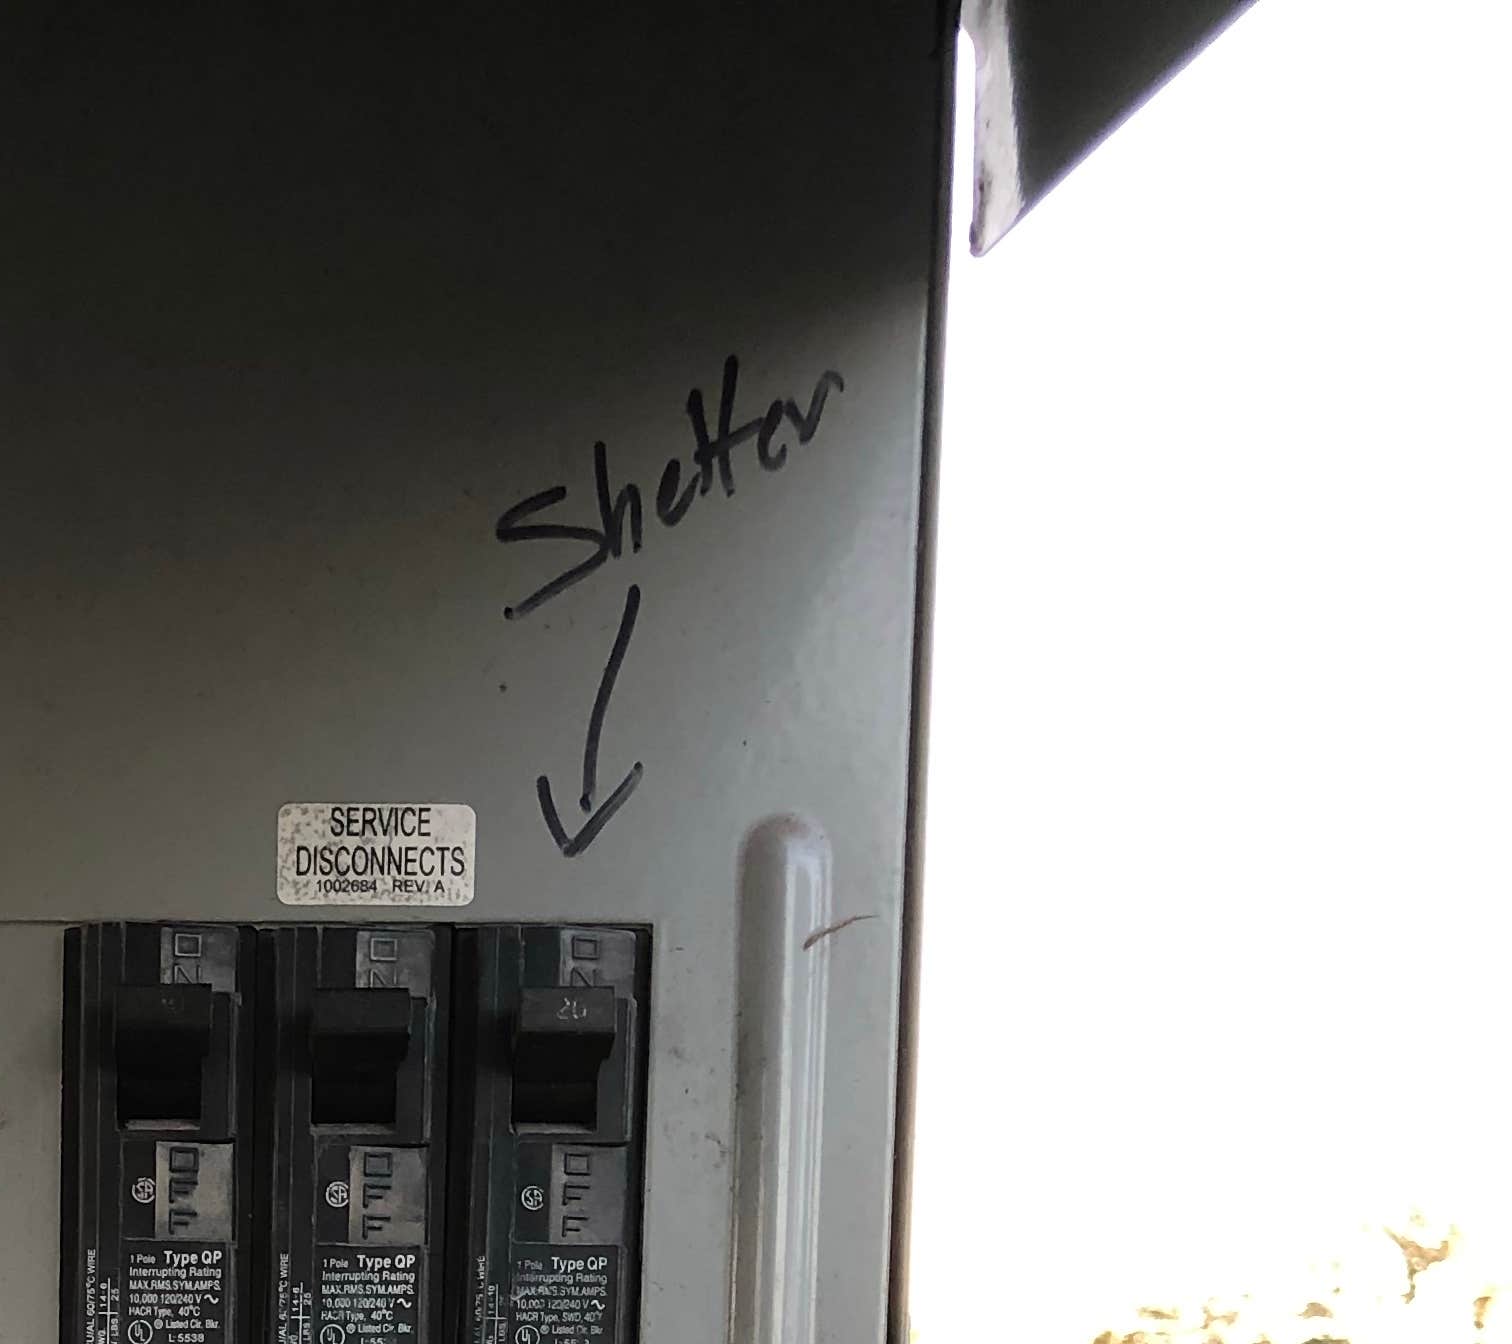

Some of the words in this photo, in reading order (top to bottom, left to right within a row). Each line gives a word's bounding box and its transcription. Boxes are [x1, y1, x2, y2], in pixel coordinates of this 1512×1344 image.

[495, 354, 844, 620] Shelter
[330, 807, 431, 836] SERVICE
[296, 846, 465, 876] DISCONNECTS
[317, 880, 377, 892] 1002684
[434, 880, 445, 892] A
[168, 1148, 199, 1235] OFF
[362, 1152, 393, 1239] OFF
[561, 1152, 590, 1238] OFF
[87, 1248, 96, 1273] WIRE
[163, 1251, 198, 1267] Type
[201, 1251, 222, 1264] QP
[280, 1253, 289, 1278] WIRE
[357, 1254, 391, 1271] Type
[395, 1255, 416, 1268] QP
[551, 1257, 584, 1272] Type
[587, 1257, 607, 1270] QP
[129, 1267, 186, 1279] Interrupting
[189, 1267, 221, 1279] Rating
[322, 1271, 379, 1282] Interrupting
[383, 1272, 415, 1282] Rating
[576, 1274, 607, 1284] Rating
[165, 1319, 188, 1329] Listed
[358, 1324, 381, 1334] Listed
[552, 1326, 574, 1334] Listed
